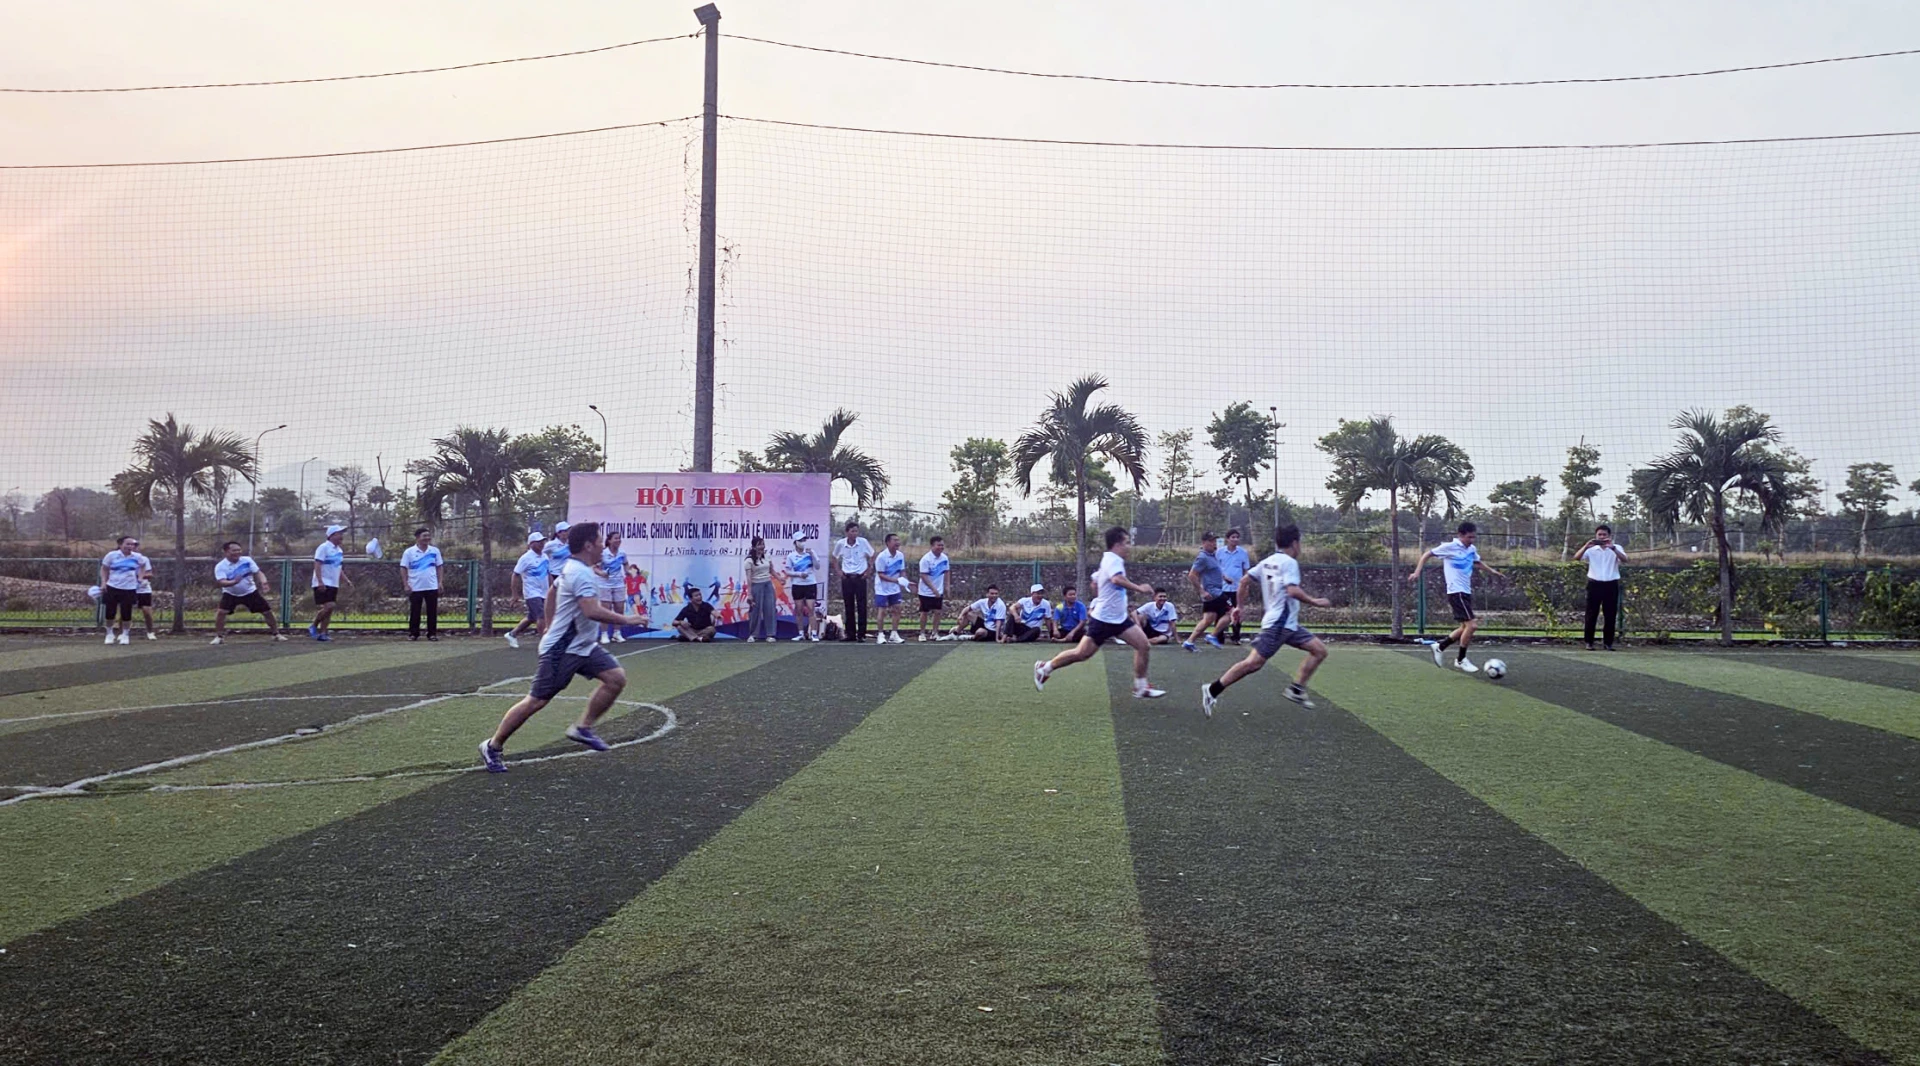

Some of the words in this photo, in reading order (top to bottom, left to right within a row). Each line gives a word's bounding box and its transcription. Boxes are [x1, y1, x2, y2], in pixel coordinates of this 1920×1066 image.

[635, 483, 686, 513] HỘI
[691, 487, 763, 507] THAO
[606, 522, 625, 539] QUAN
[650, 519, 673, 539] CHÍNH
[702, 519, 718, 543] MẶT
[720, 519, 738, 543] TRẬN
[740, 520, 750, 539] XÃ
[763, 523, 780, 539] NINH
[782, 520, 800, 539] NĂM
[802, 523, 819, 540] 2026
[664, 547, 674, 557] Lệ
[676, 546, 697, 556] Ninh,
[699, 548, 717, 557] ngày
[719, 547, 729, 556] 08
[735, 547, 743, 556] 11
[769, 547, 774, 556] 4
[775, 547, 792, 556] năm
